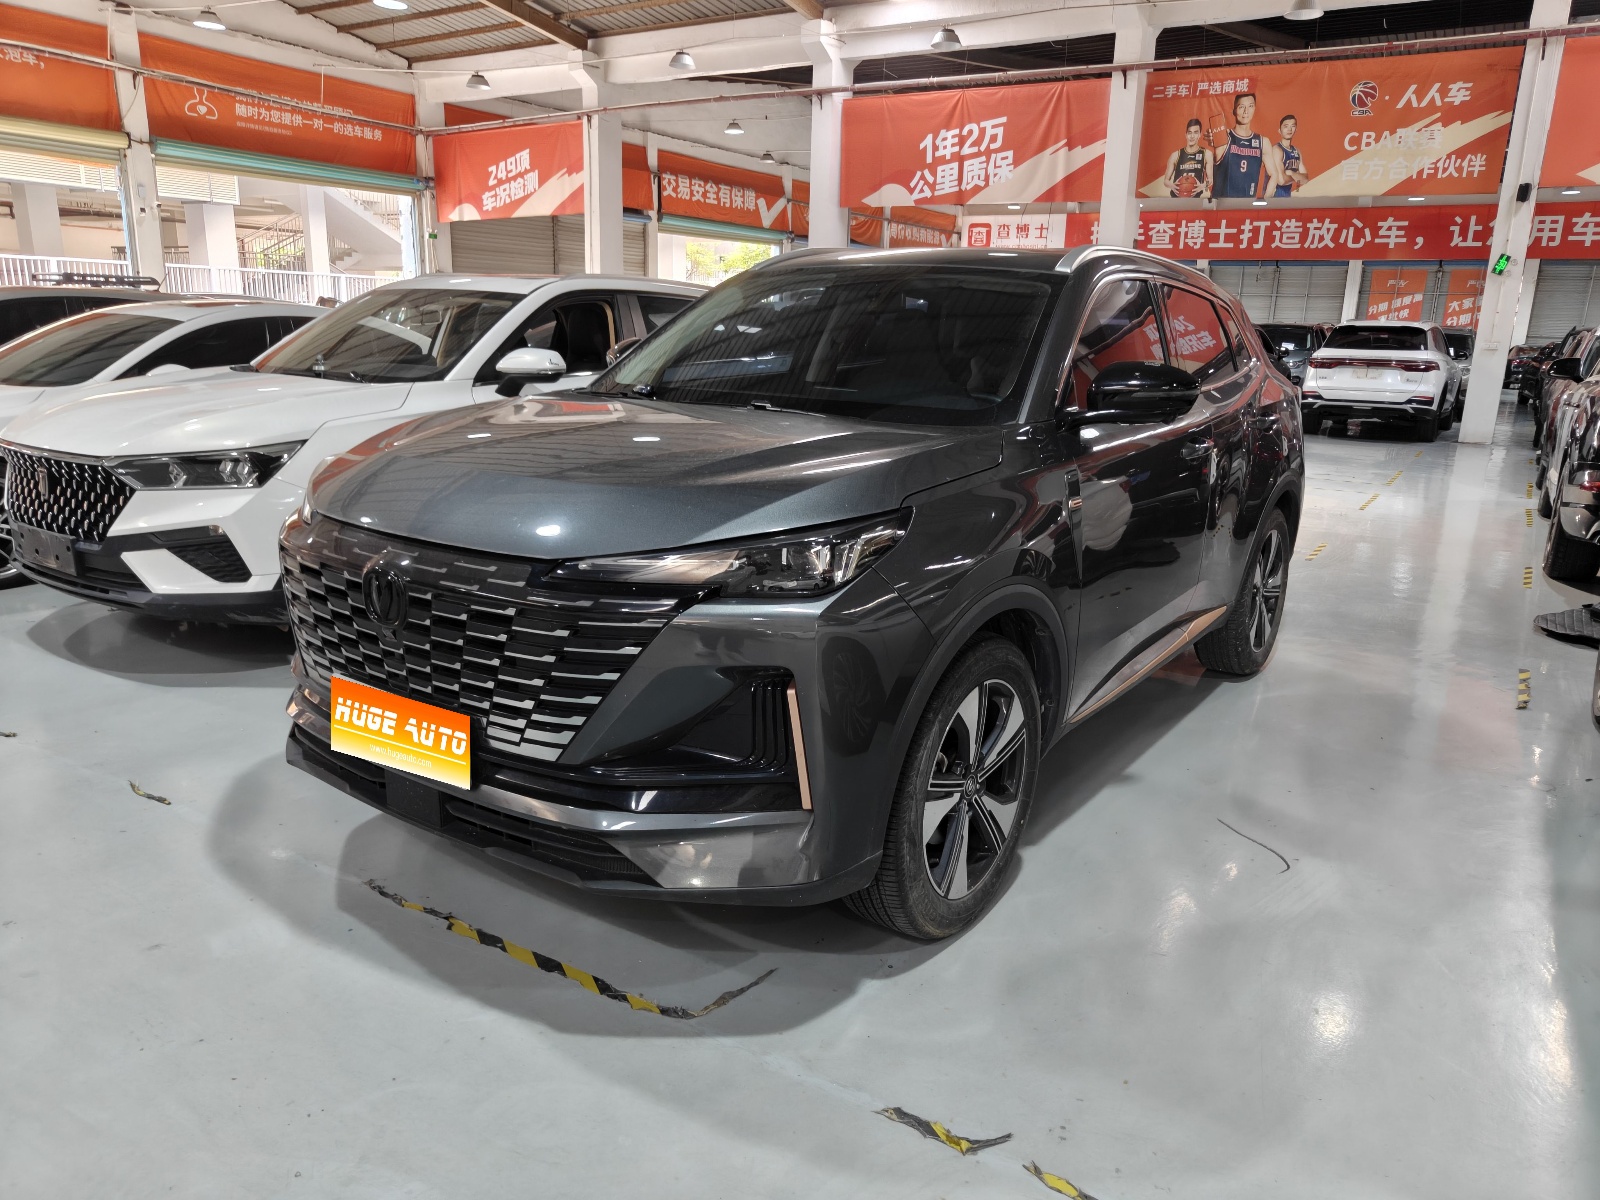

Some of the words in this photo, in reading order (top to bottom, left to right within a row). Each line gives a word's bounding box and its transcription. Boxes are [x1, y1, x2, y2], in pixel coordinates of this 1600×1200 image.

[1152, 85, 1190, 99] 二手车
[1196, 78, 1249, 96] 严选商城
[1396, 81, 1474, 109] 人人车
[235, 103, 383, 142] 随时为您提供一对一的选车服务
[1350, 108, 1374, 117] CBA
[919, 116, 1007, 164] 1年2万
[1343, 126, 1445, 151] CBA联赛
[487, 148, 531, 187] 249项
[909, 150, 1014, 201] 公里质保
[1240, 160, 1248, 172] 9
[1340, 153, 1487, 181] 官方合作伙伴
[481, 169, 539, 212] 车况检测
[662, 171, 757, 212] 交易安全有保障
[996, 222, 1048, 240] 查博士
